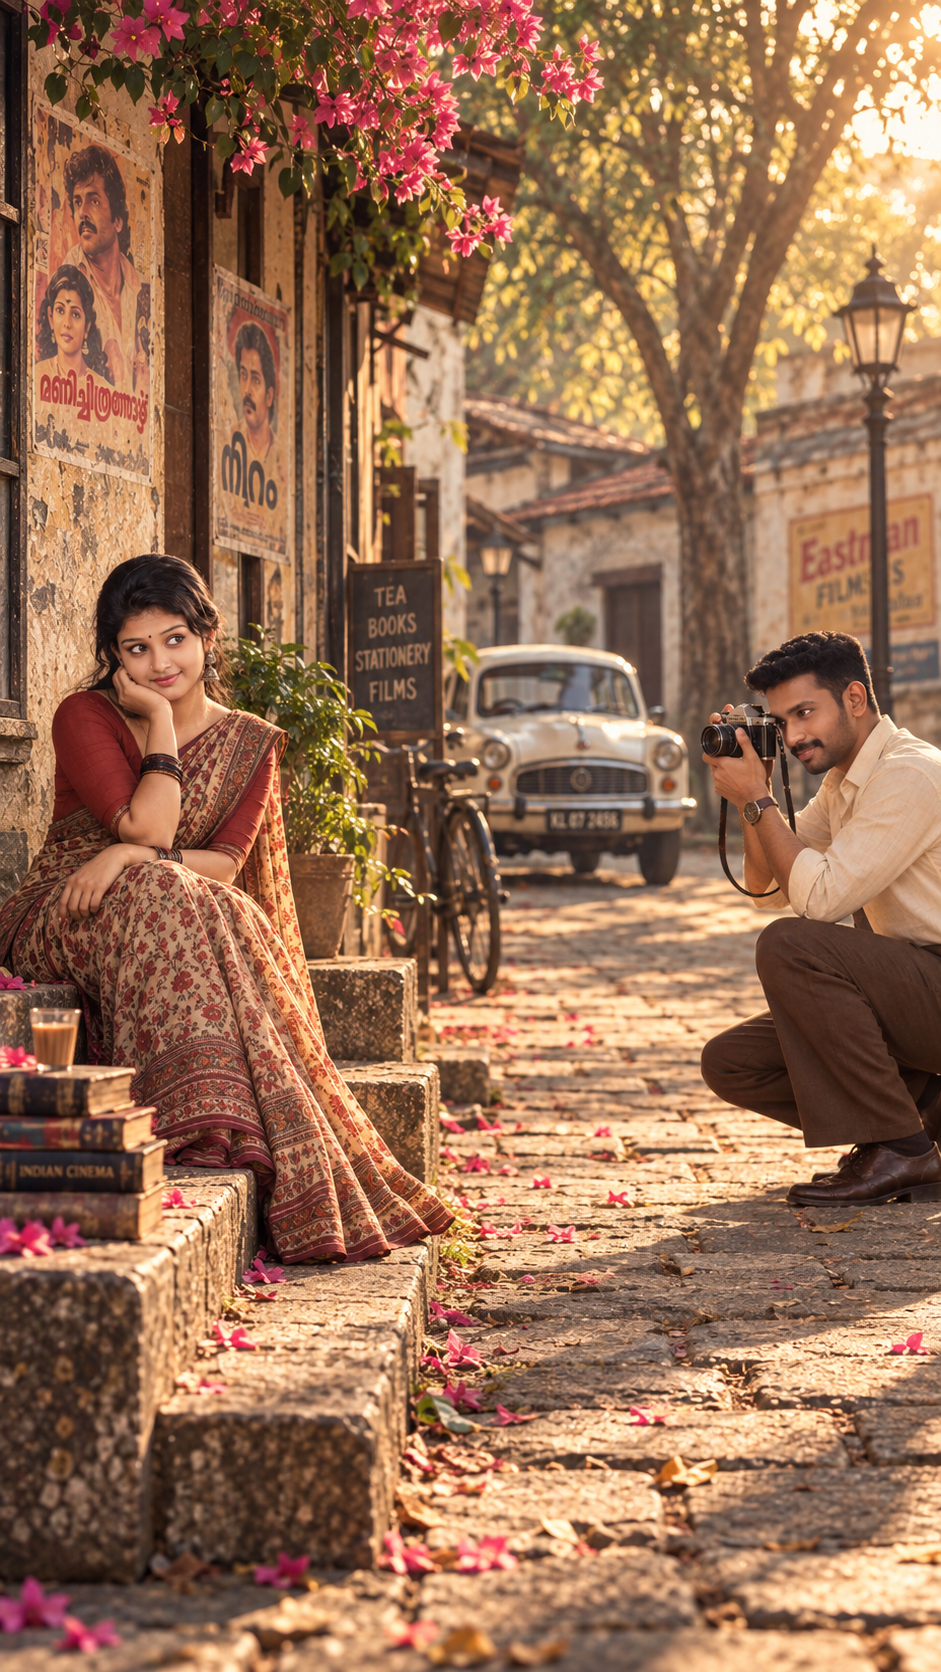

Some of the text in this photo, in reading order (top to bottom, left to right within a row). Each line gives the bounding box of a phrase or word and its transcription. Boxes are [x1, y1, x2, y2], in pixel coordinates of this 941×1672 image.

[374, 585, 407, 607] TEA
[368, 612, 417, 639] BOOKS
[355, 642, 432, 672] STATIONERY
[369, 677, 417, 703] FILMS
[19, 1165, 115, 1179] INDIAN CINEMA
